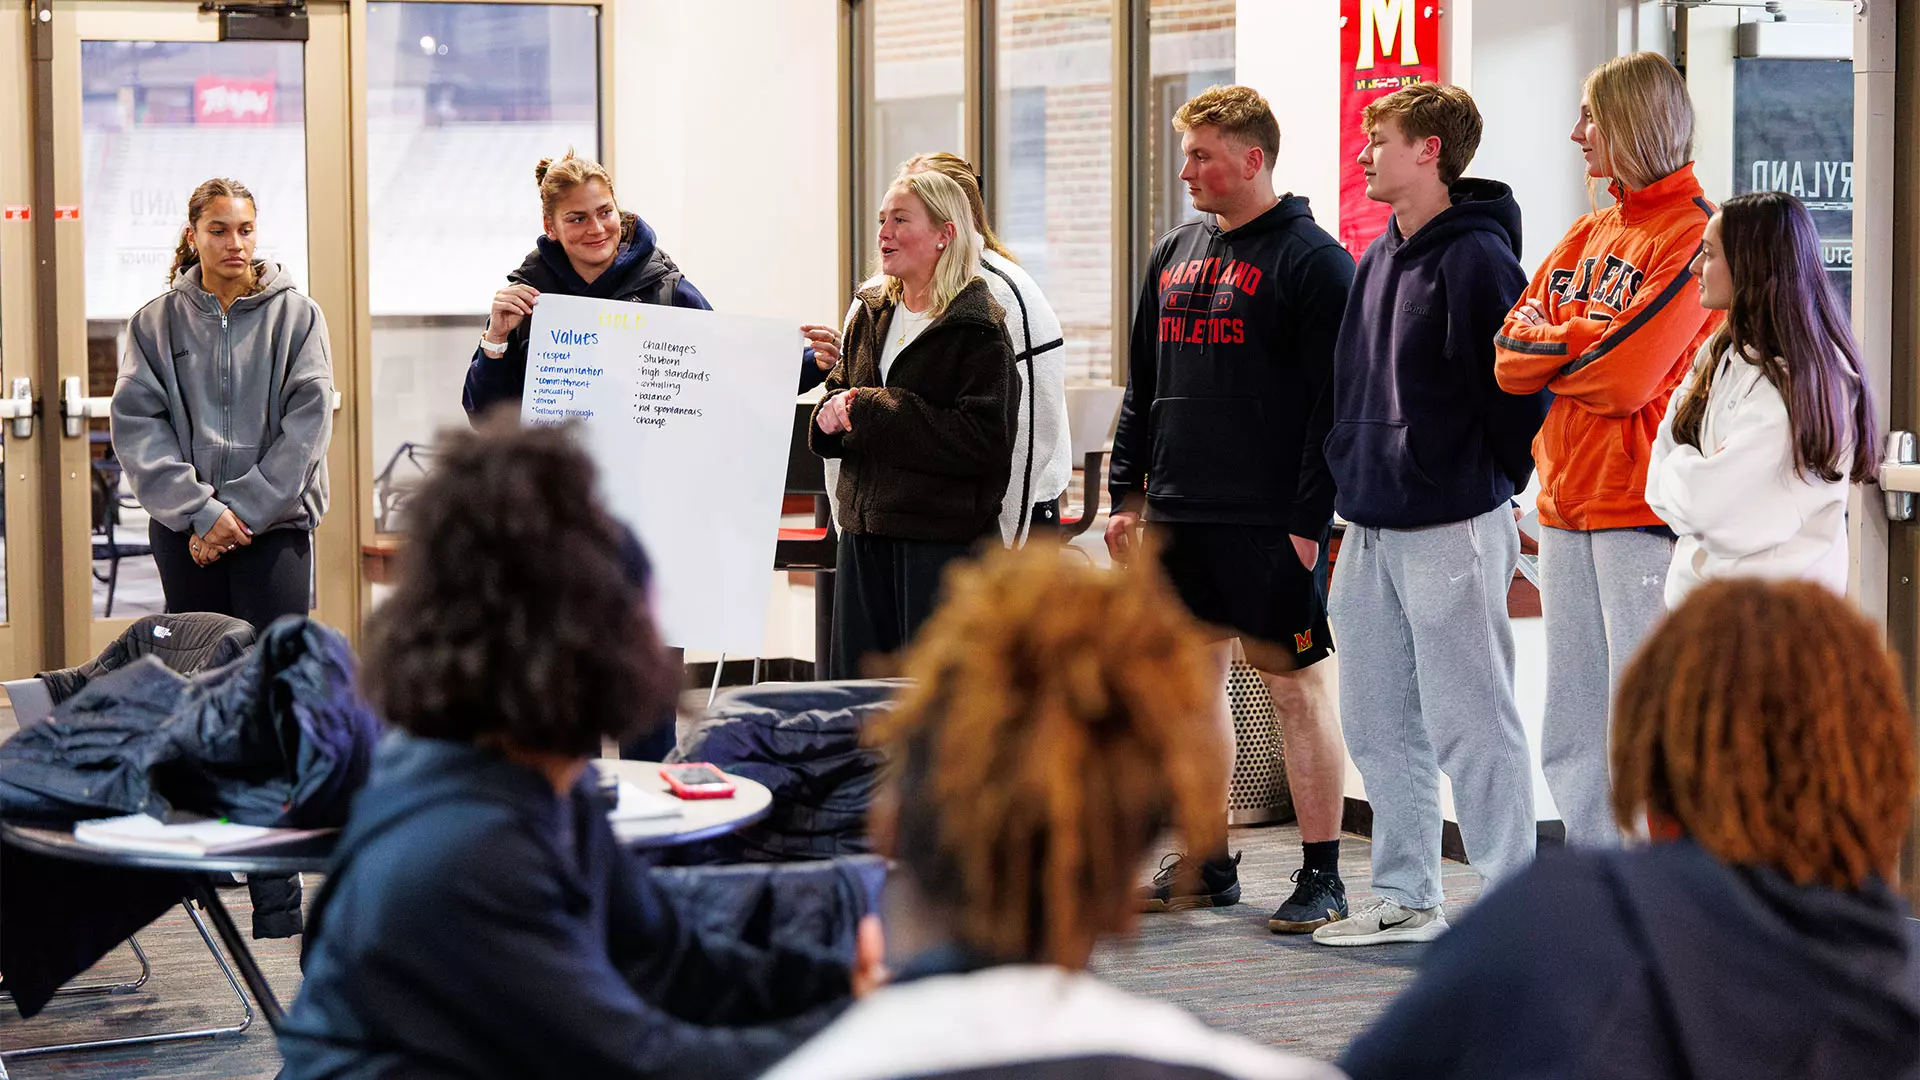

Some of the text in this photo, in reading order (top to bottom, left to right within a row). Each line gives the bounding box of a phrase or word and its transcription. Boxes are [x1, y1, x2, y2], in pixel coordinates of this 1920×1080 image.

[1354, 0, 1421, 71] M
[1159, 256, 1263, 297] MARYLAND
[598, 308, 648, 331] GOLD
[550, 328, 599, 346] Values
[543, 351, 571, 362] respect
[539, 365, 604, 376] communication
[641, 366, 711, 382] high standards
[640, 381, 681, 396] controlling
[639, 392, 672, 401] balance
[638, 404, 651, 413] not
[635, 416, 666, 429] change
[1293, 628, 1314, 654] M
